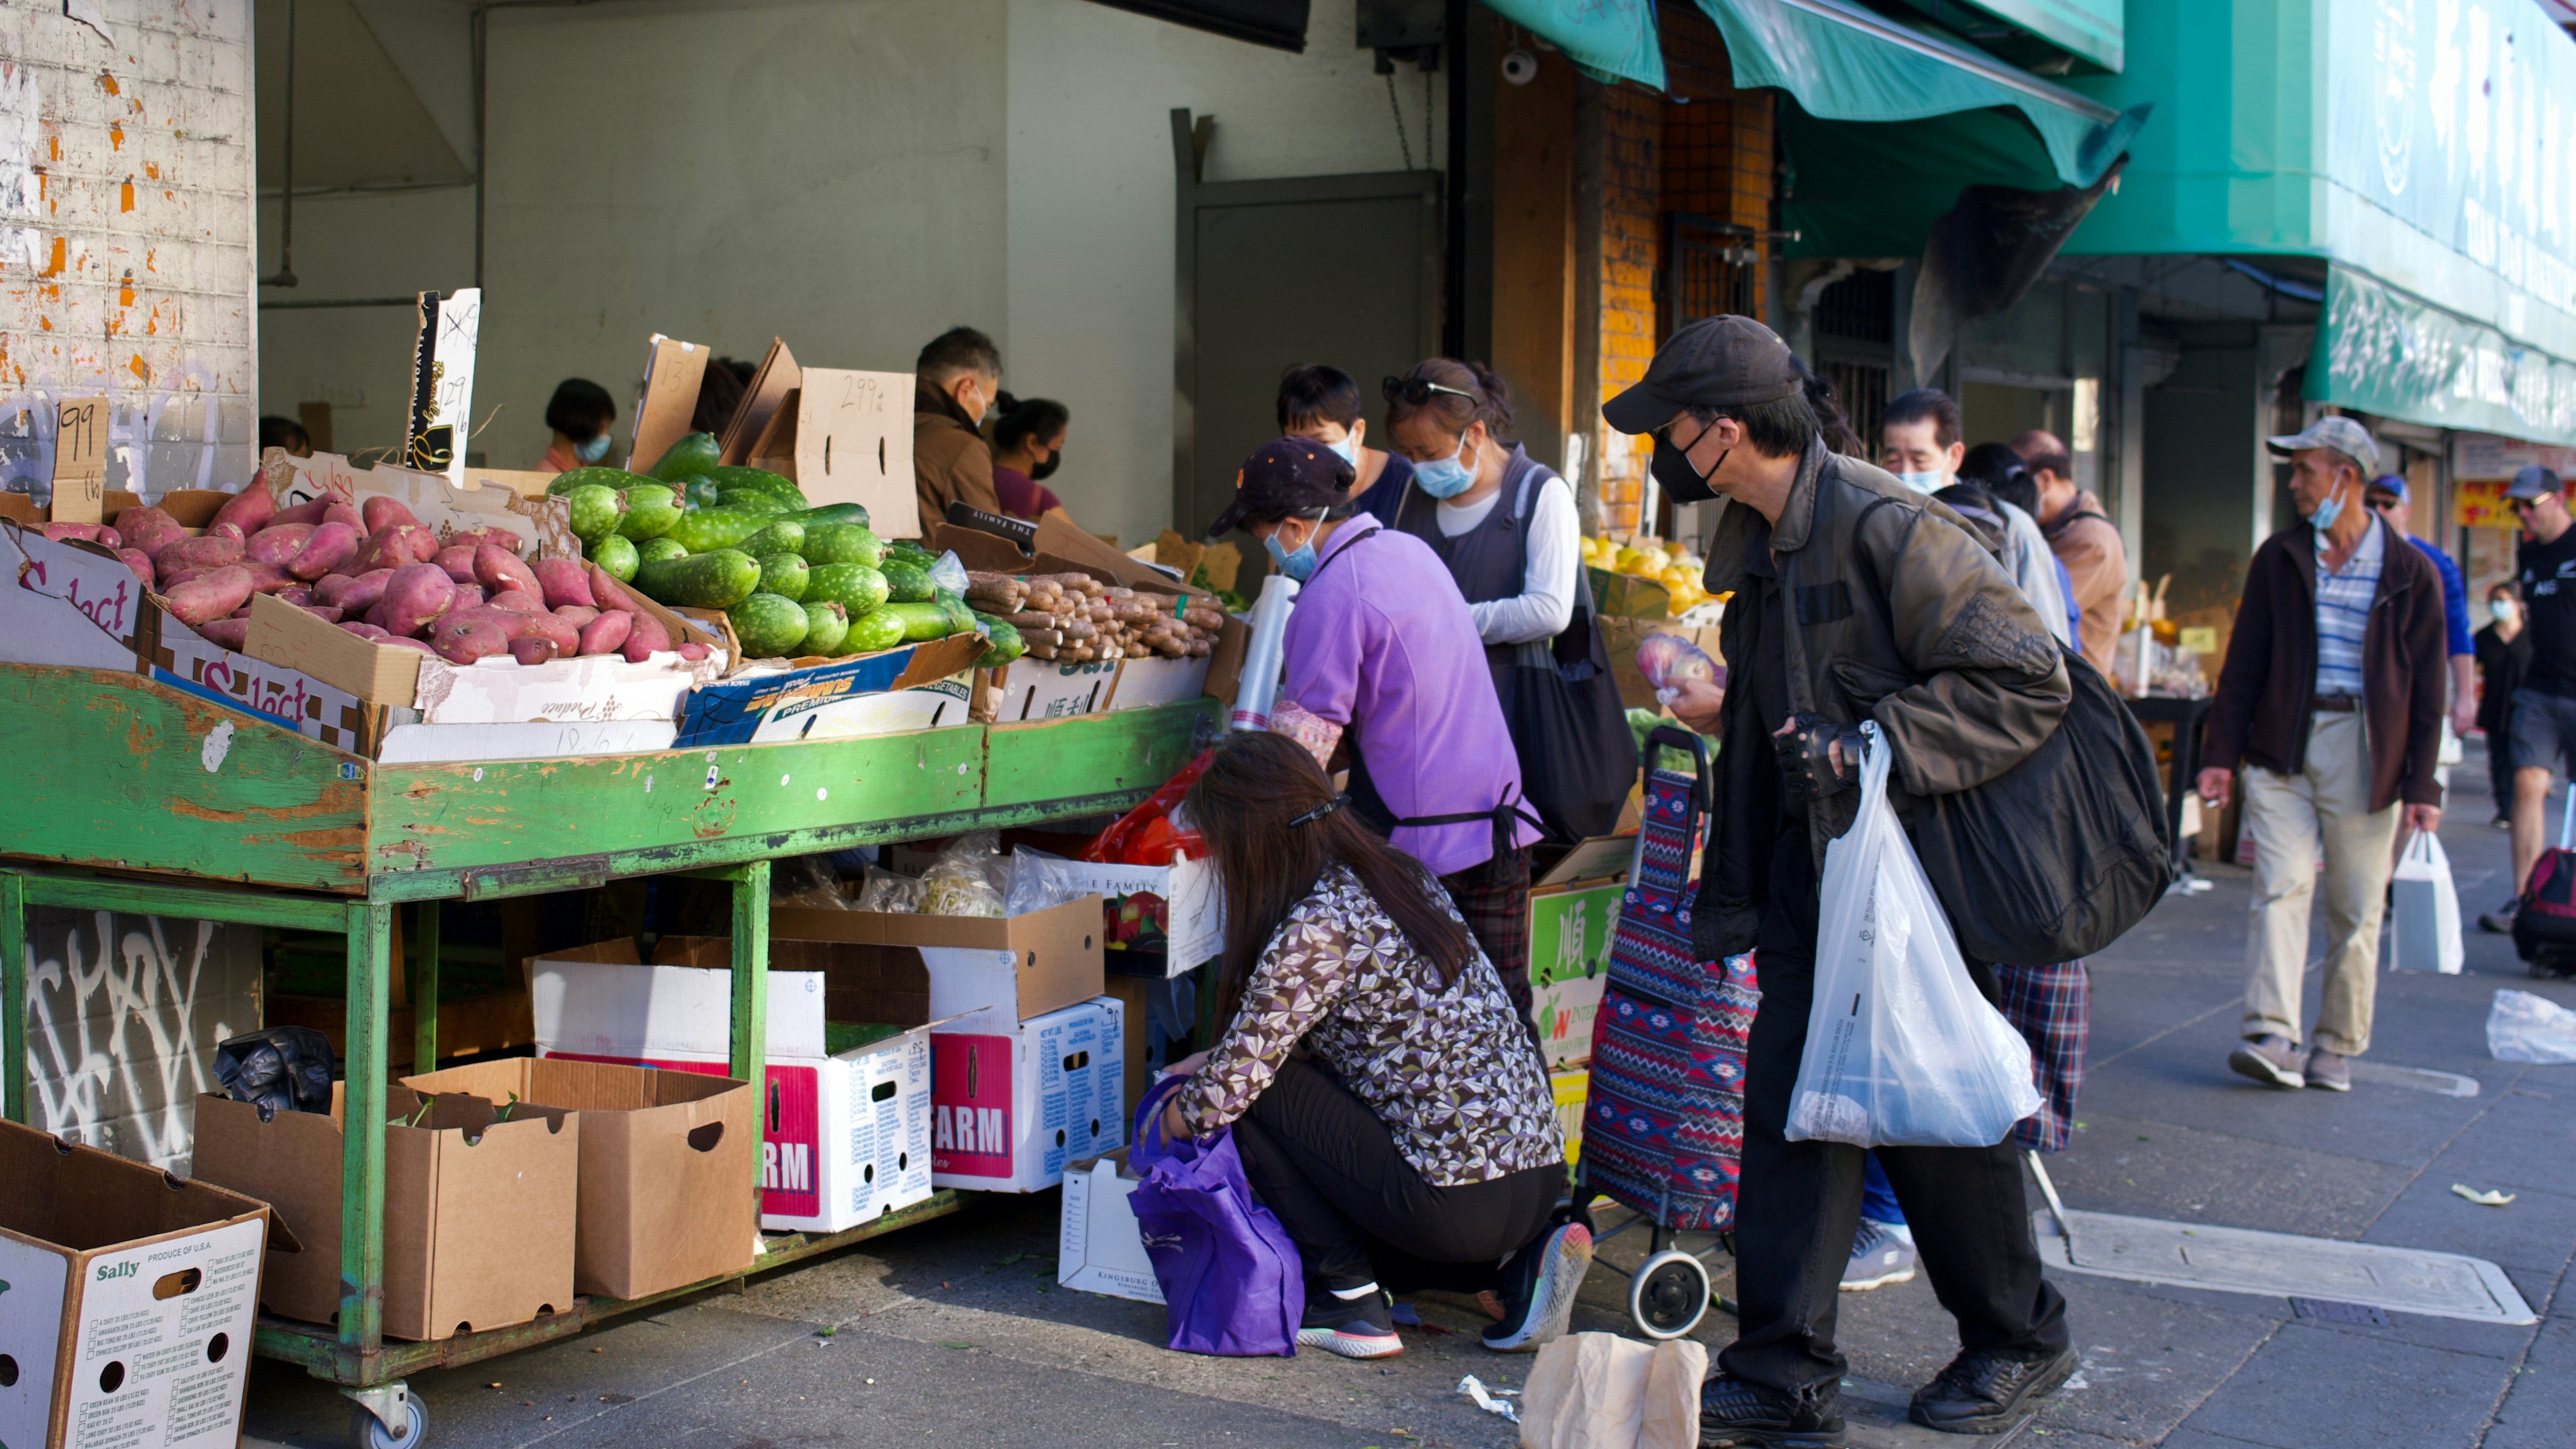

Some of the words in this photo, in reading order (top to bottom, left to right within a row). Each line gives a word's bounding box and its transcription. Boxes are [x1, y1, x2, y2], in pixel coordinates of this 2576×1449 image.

[61, 403, 94, 462] 99
[972, 510, 1007, 528] FAMILY
[1011, 523, 1031, 536] THE
[540, 702, 597, 721] Produce
[1106, 879, 1158, 892] FAMILY
[931, 1105, 1004, 1154] ARM
[148, 1248, 182, 1263] PRODUCE
[183, 1246, 192, 1254] OF
[194, 1242, 212, 1252] U.S.A.
[96, 1261, 140, 1281] Sally
[1098, 1271, 1147, 1285] KINGSBURG
[90, 1400, 103, 1409] GREEN
[89, 1411, 101, 1419] GREEN
